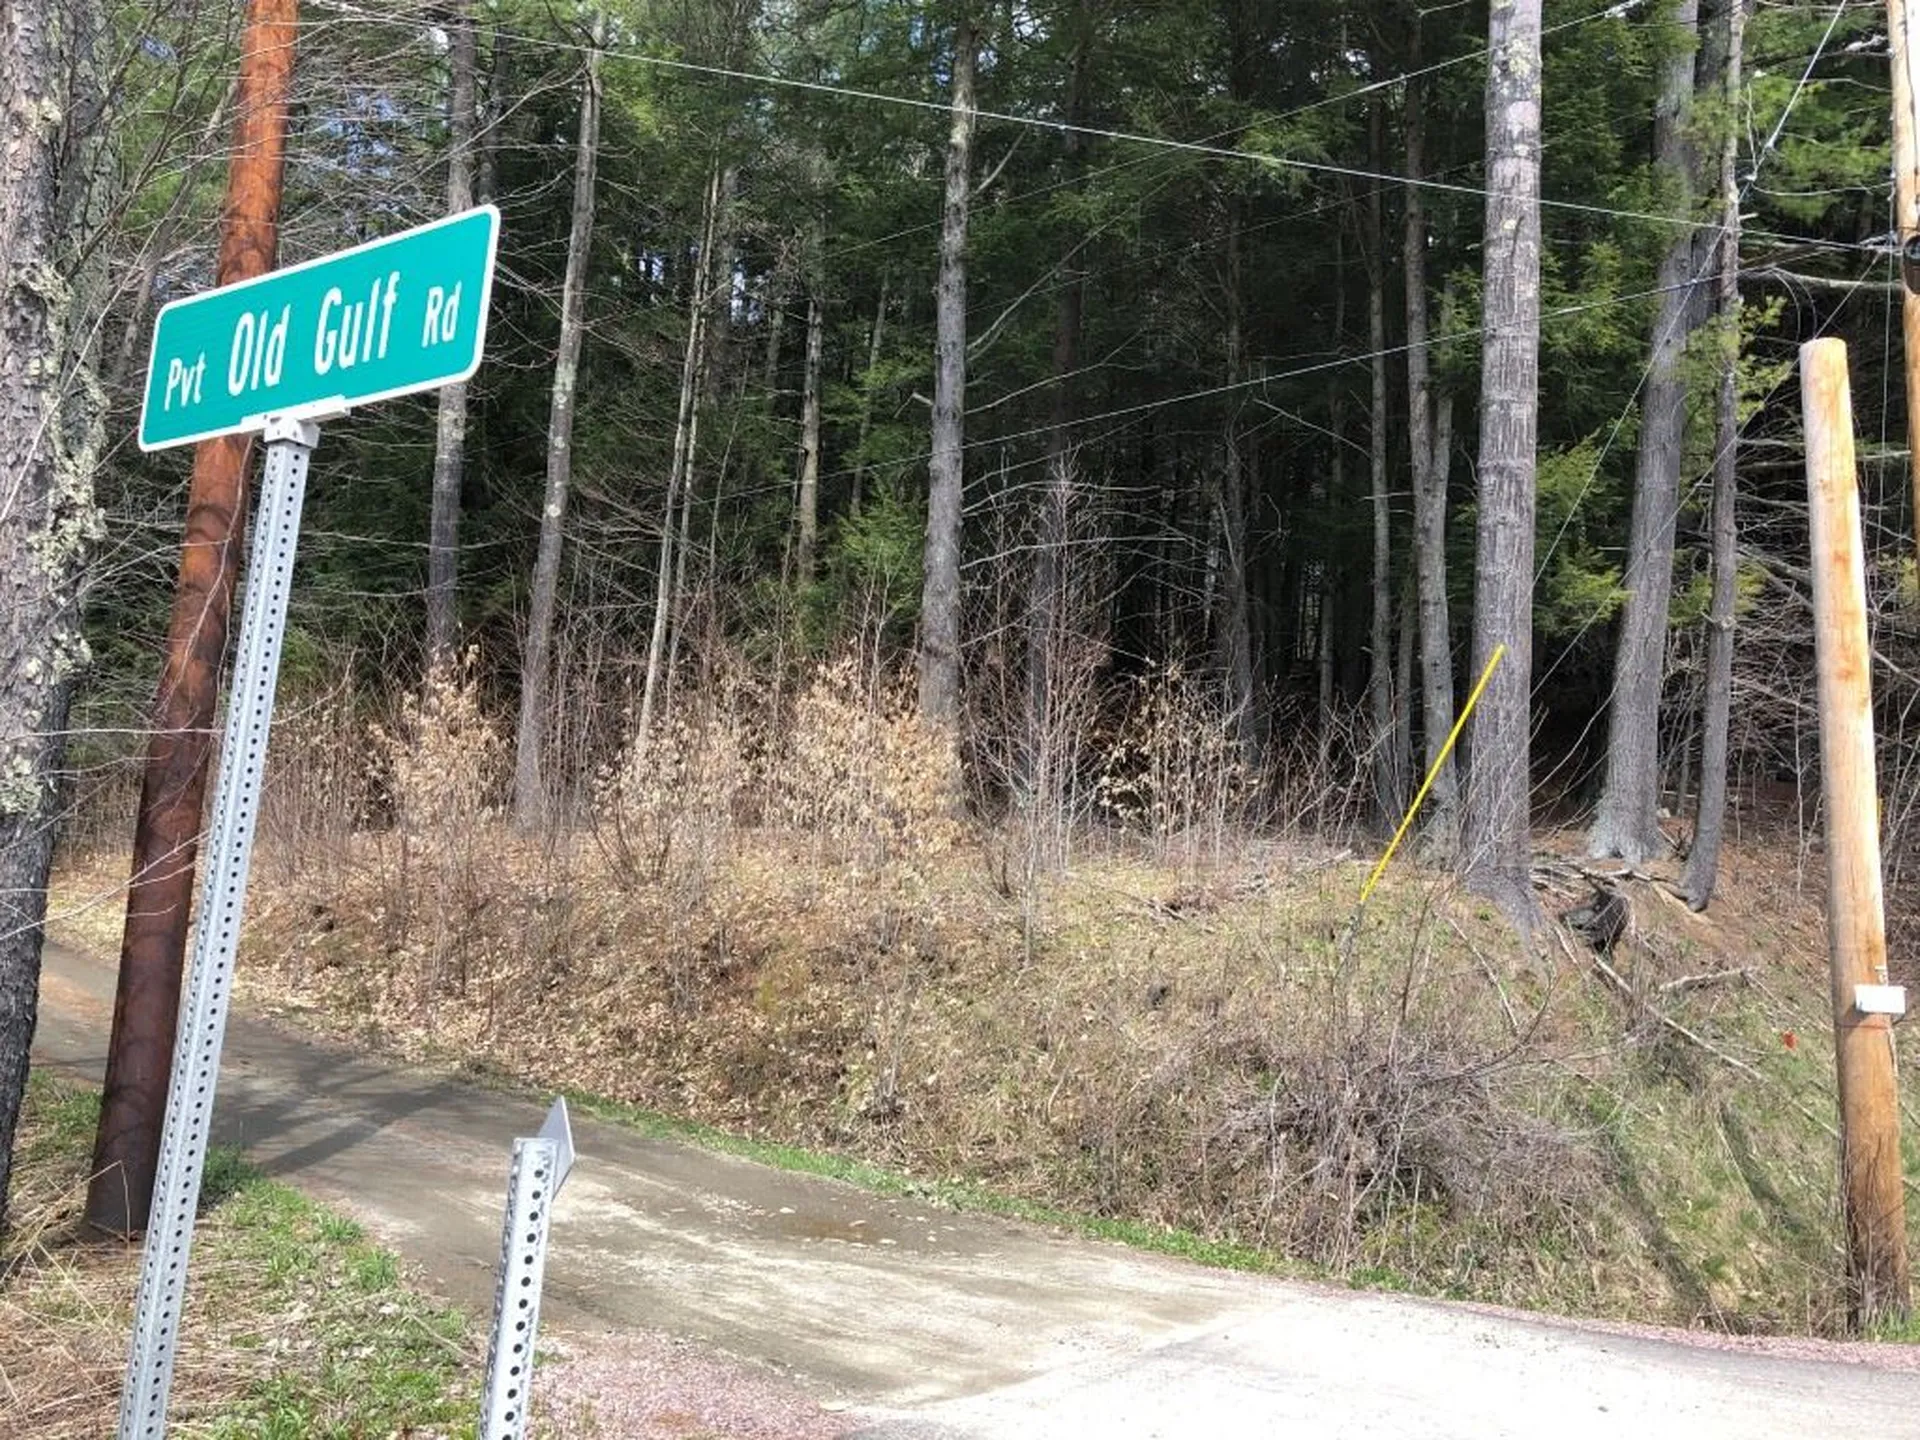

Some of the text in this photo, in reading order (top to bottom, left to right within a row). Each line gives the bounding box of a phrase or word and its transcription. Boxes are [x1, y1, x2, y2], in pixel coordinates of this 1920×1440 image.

[164, 271, 462, 411] Pvt Old Gulf Rd
